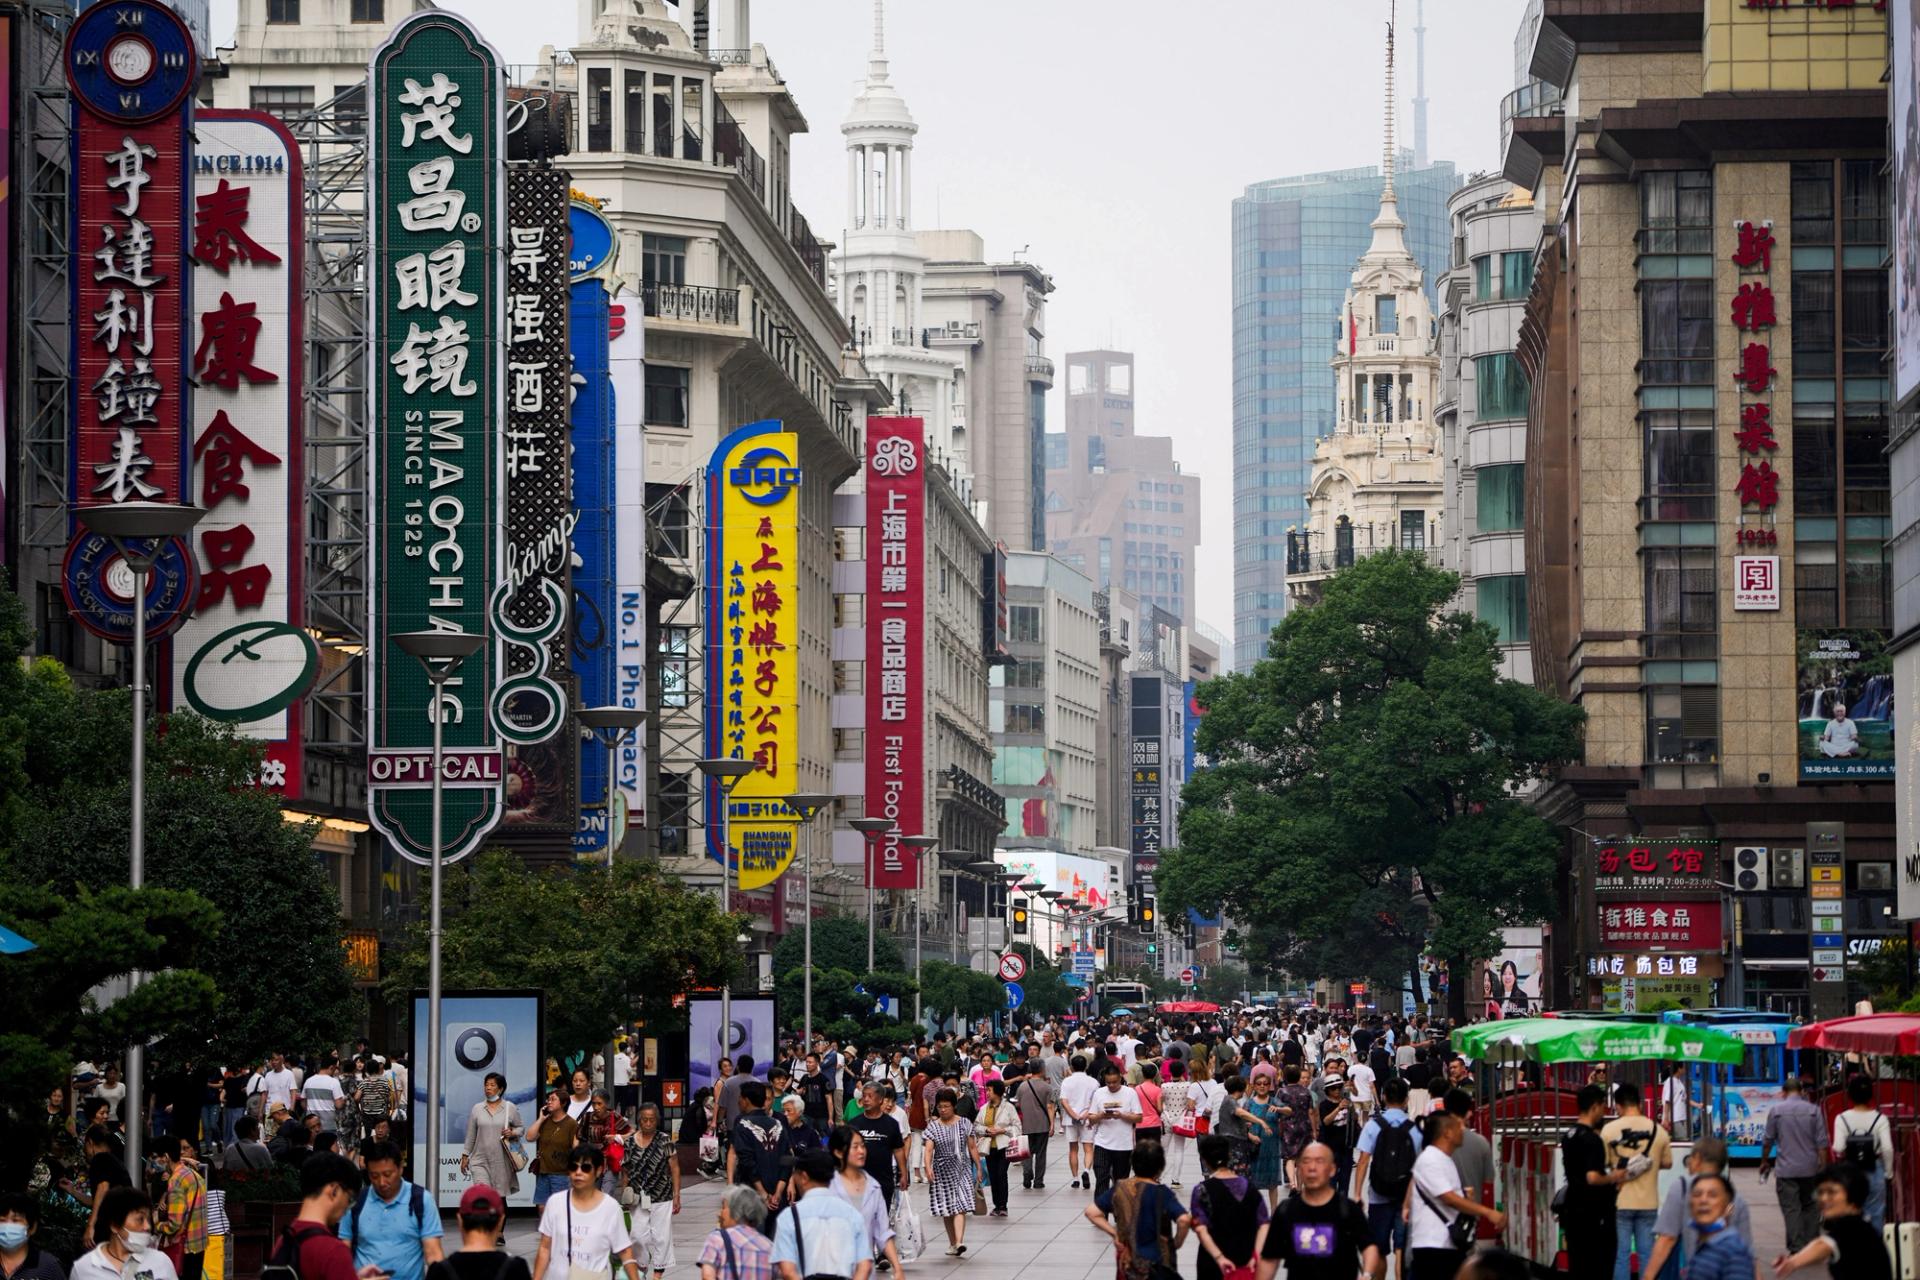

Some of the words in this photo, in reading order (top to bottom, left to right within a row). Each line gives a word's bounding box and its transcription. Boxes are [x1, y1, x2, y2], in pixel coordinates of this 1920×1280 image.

[391, 72, 478, 396] 茂昌眼镜
[193, 177, 282, 617] 泰康食品
[405, 410, 423, 485] SINCE
[405, 499, 423, 557] 1923
[621, 592, 640, 650] No.1
[882, 490, 907, 720] 上海市第一食品商店
[618, 665, 641, 792] Phamacy
[884, 735, 903, 775] First
[371, 756, 498, 780] OPTCAL
[743, 831, 791, 841] SHANGHAI
[1142, 797, 1160, 853] 真丝大王
[1606, 907, 1691, 928] 新雅食品
[1637, 956, 1698, 975] 汤包馆
